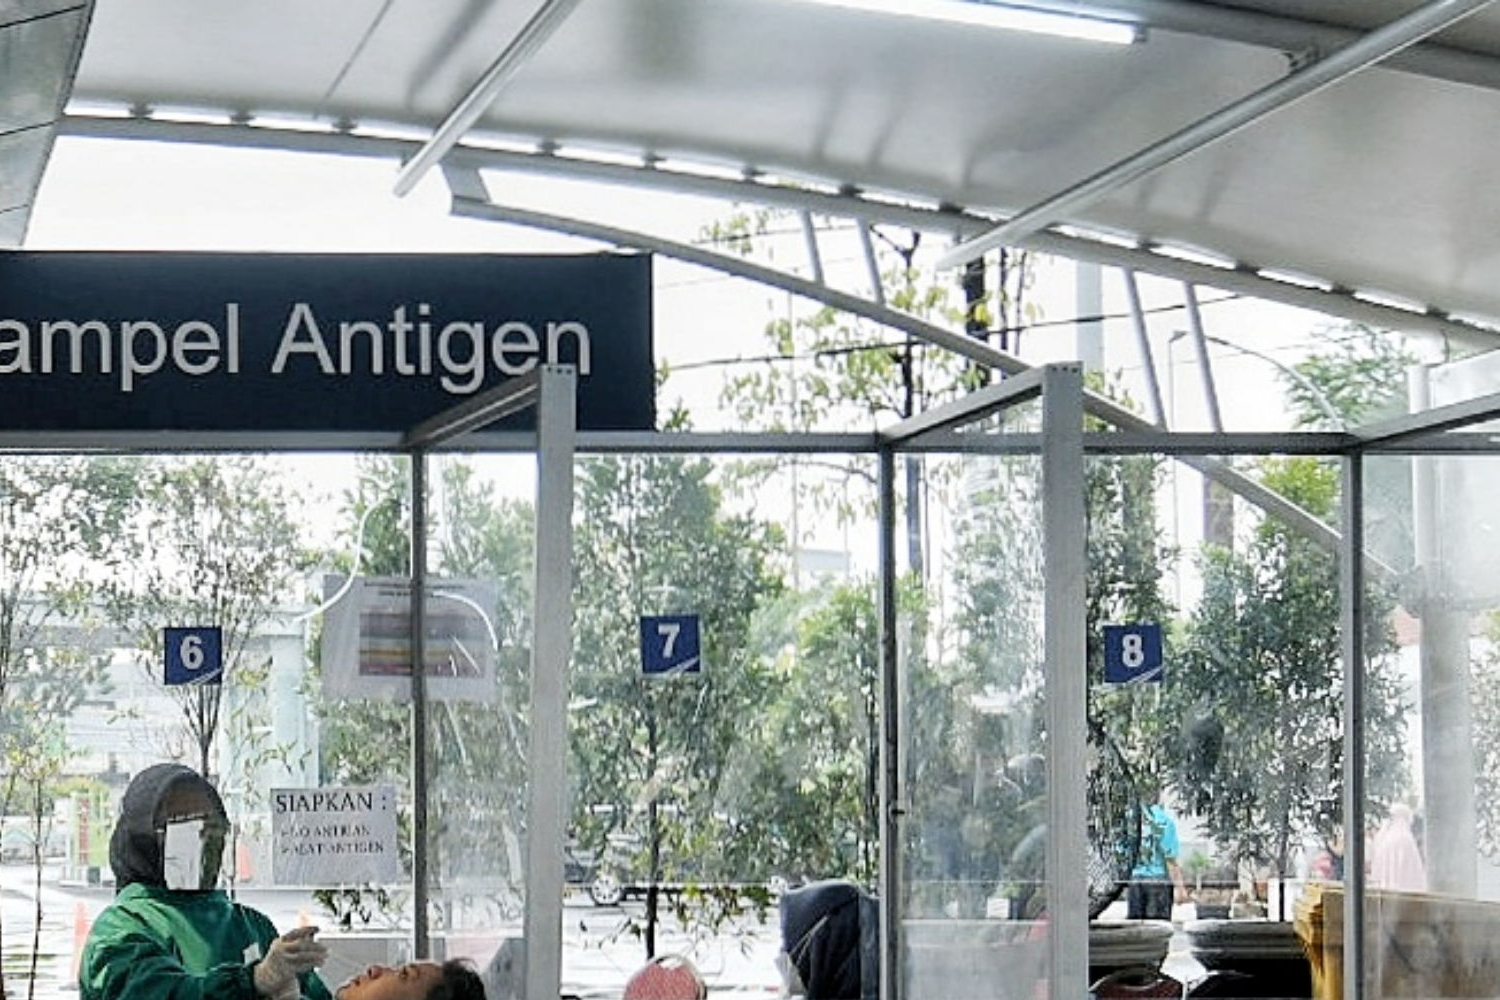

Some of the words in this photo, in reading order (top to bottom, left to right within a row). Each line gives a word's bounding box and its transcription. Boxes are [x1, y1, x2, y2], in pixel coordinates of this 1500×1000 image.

[271, 302, 592, 395] Antigen
[179, 634, 204, 670] 6
[657, 623, 681, 659] 7
[1121, 633, 1144, 668] 8
[275, 791, 372, 814] SIAPKAN
